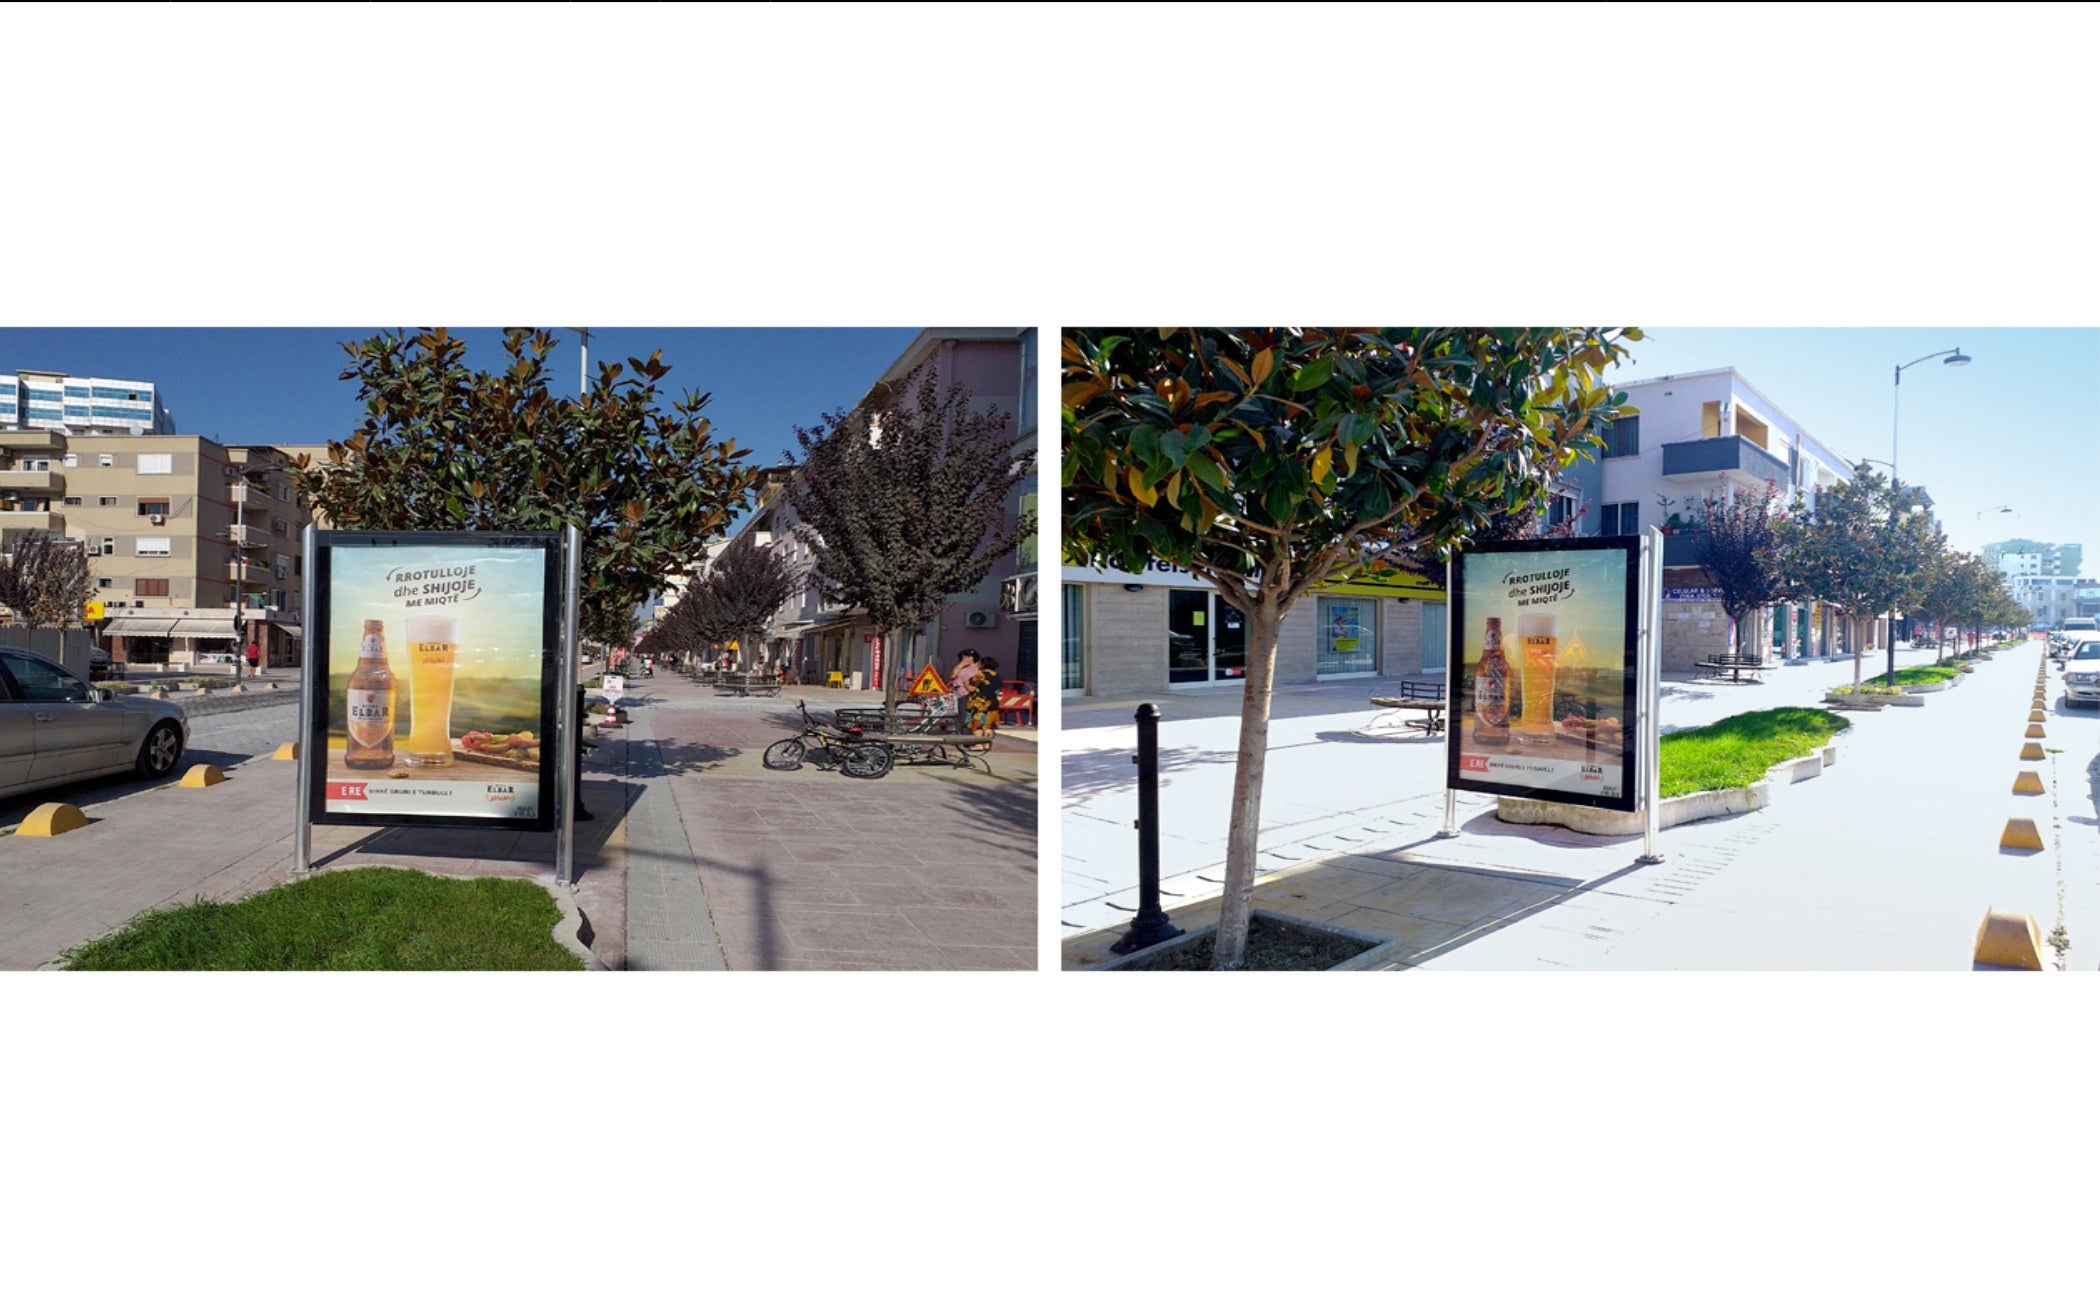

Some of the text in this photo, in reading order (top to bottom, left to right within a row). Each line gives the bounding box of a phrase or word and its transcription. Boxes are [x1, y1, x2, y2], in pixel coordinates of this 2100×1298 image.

[396, 565, 476, 582] RROTULLOJE
[1509, 568, 1570, 585] RROTULLOJE
[394, 580, 476, 597] dhe SHIJOJE
[1508, 581, 1570, 598] dhe SHIJOJE
[406, 599, 422, 607] ME
[419, 643, 448, 652] ELBAR
[352, 706, 389, 717] ELBAR
[341, 786, 361, 796] E RE
[487, 785, 514, 793] ELBAR
